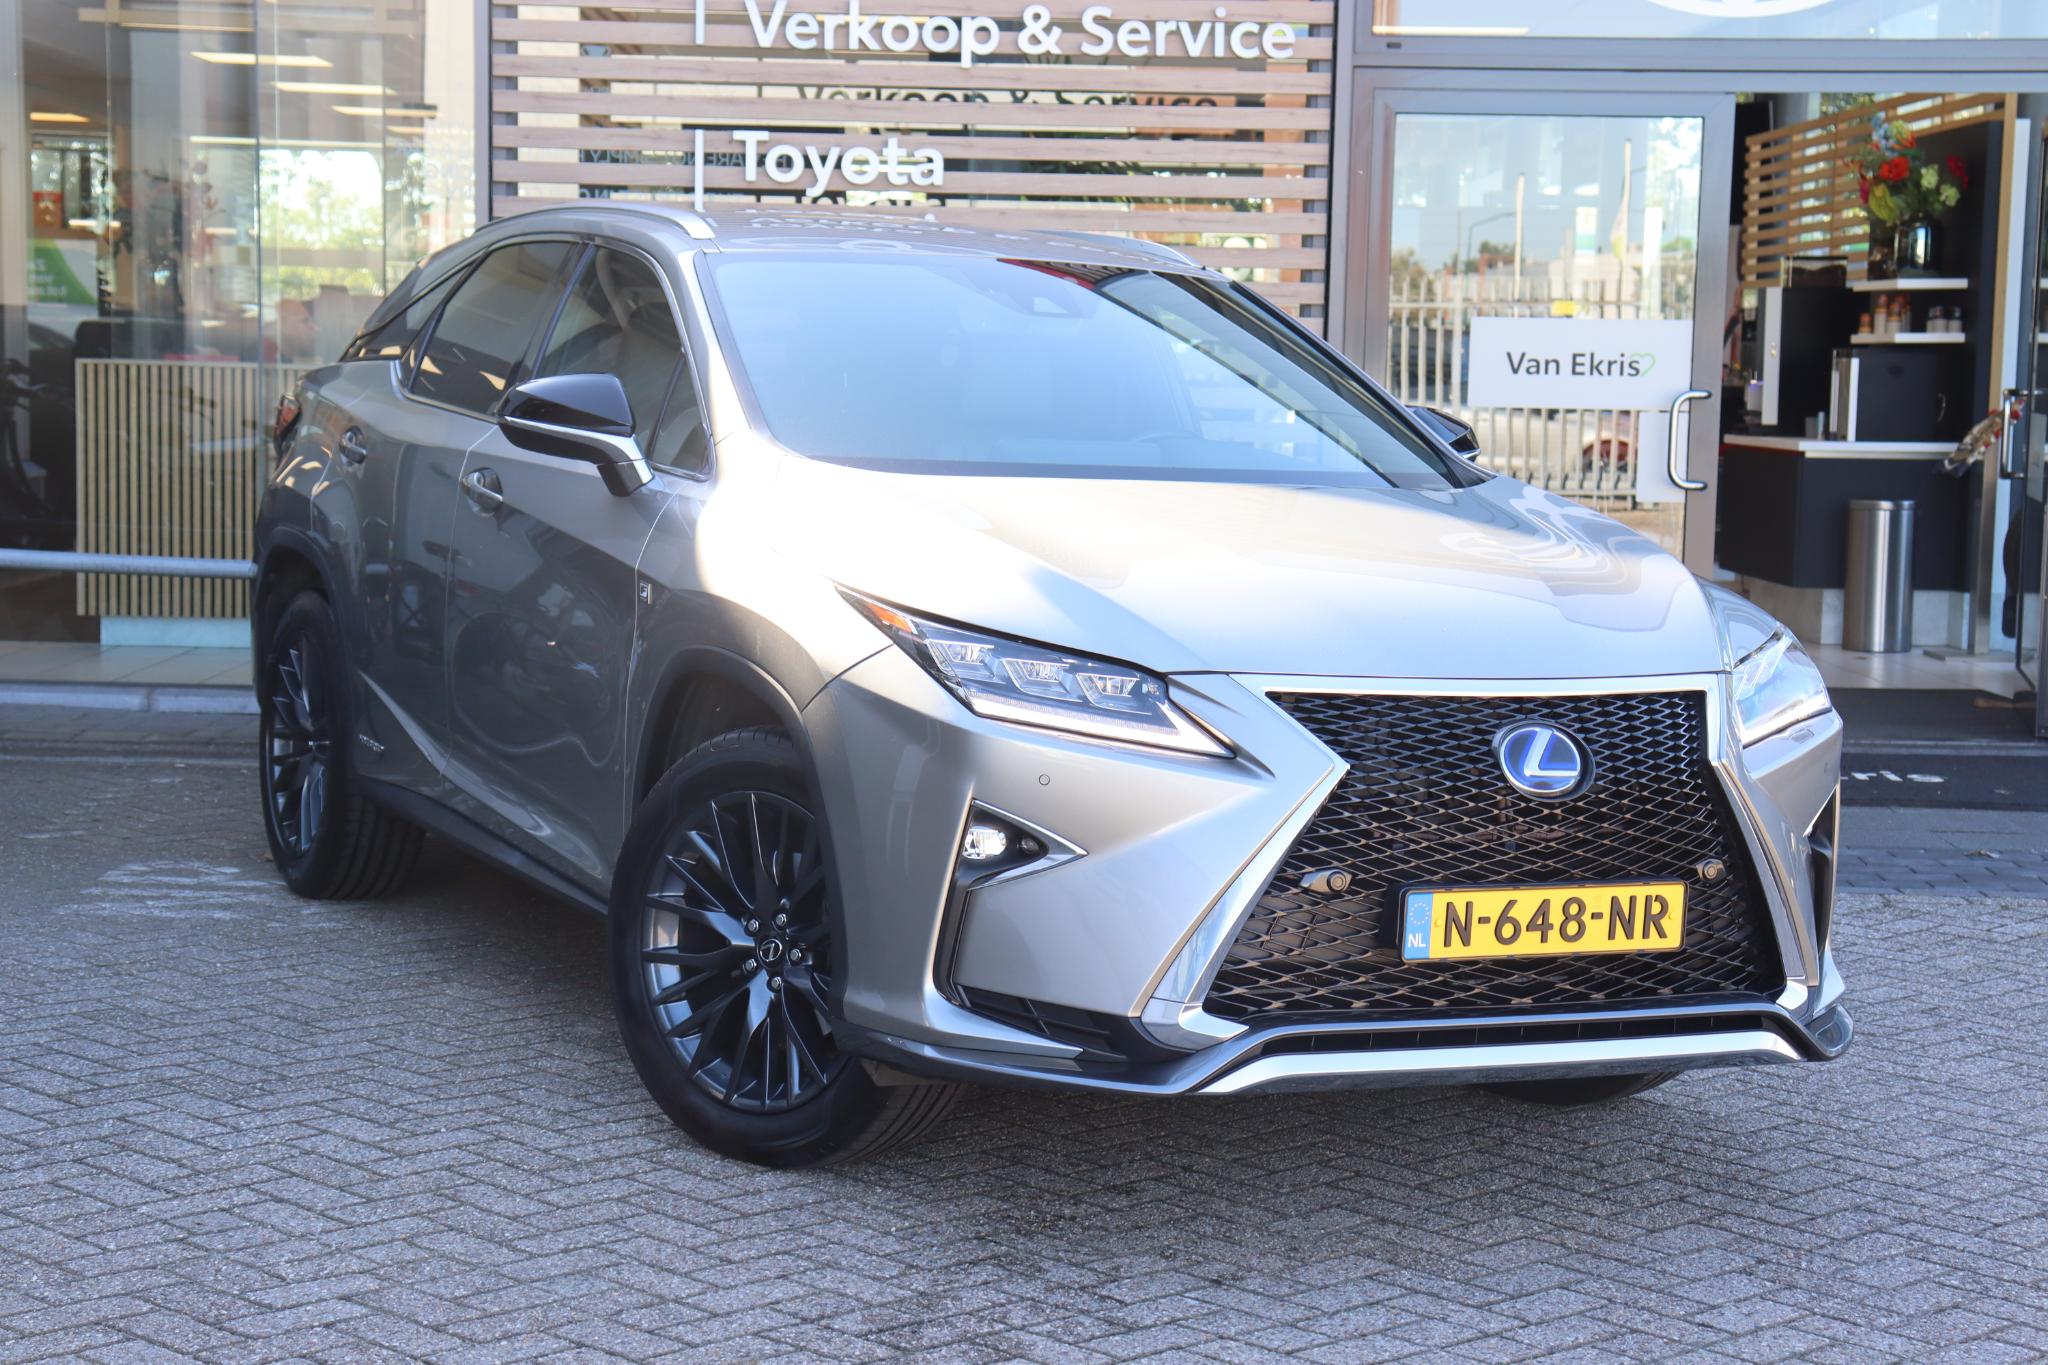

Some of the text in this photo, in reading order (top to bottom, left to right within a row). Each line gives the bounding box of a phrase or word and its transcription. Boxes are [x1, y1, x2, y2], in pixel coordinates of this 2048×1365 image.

[743, 0, 1296, 69] Verkoop & Service
[732, 131, 945, 197] Toyota
[1506, 352, 1641, 377] Van Ekris
[1408, 932, 1427, 948] NL
[1443, 894, 1669, 948] N-648-NR
